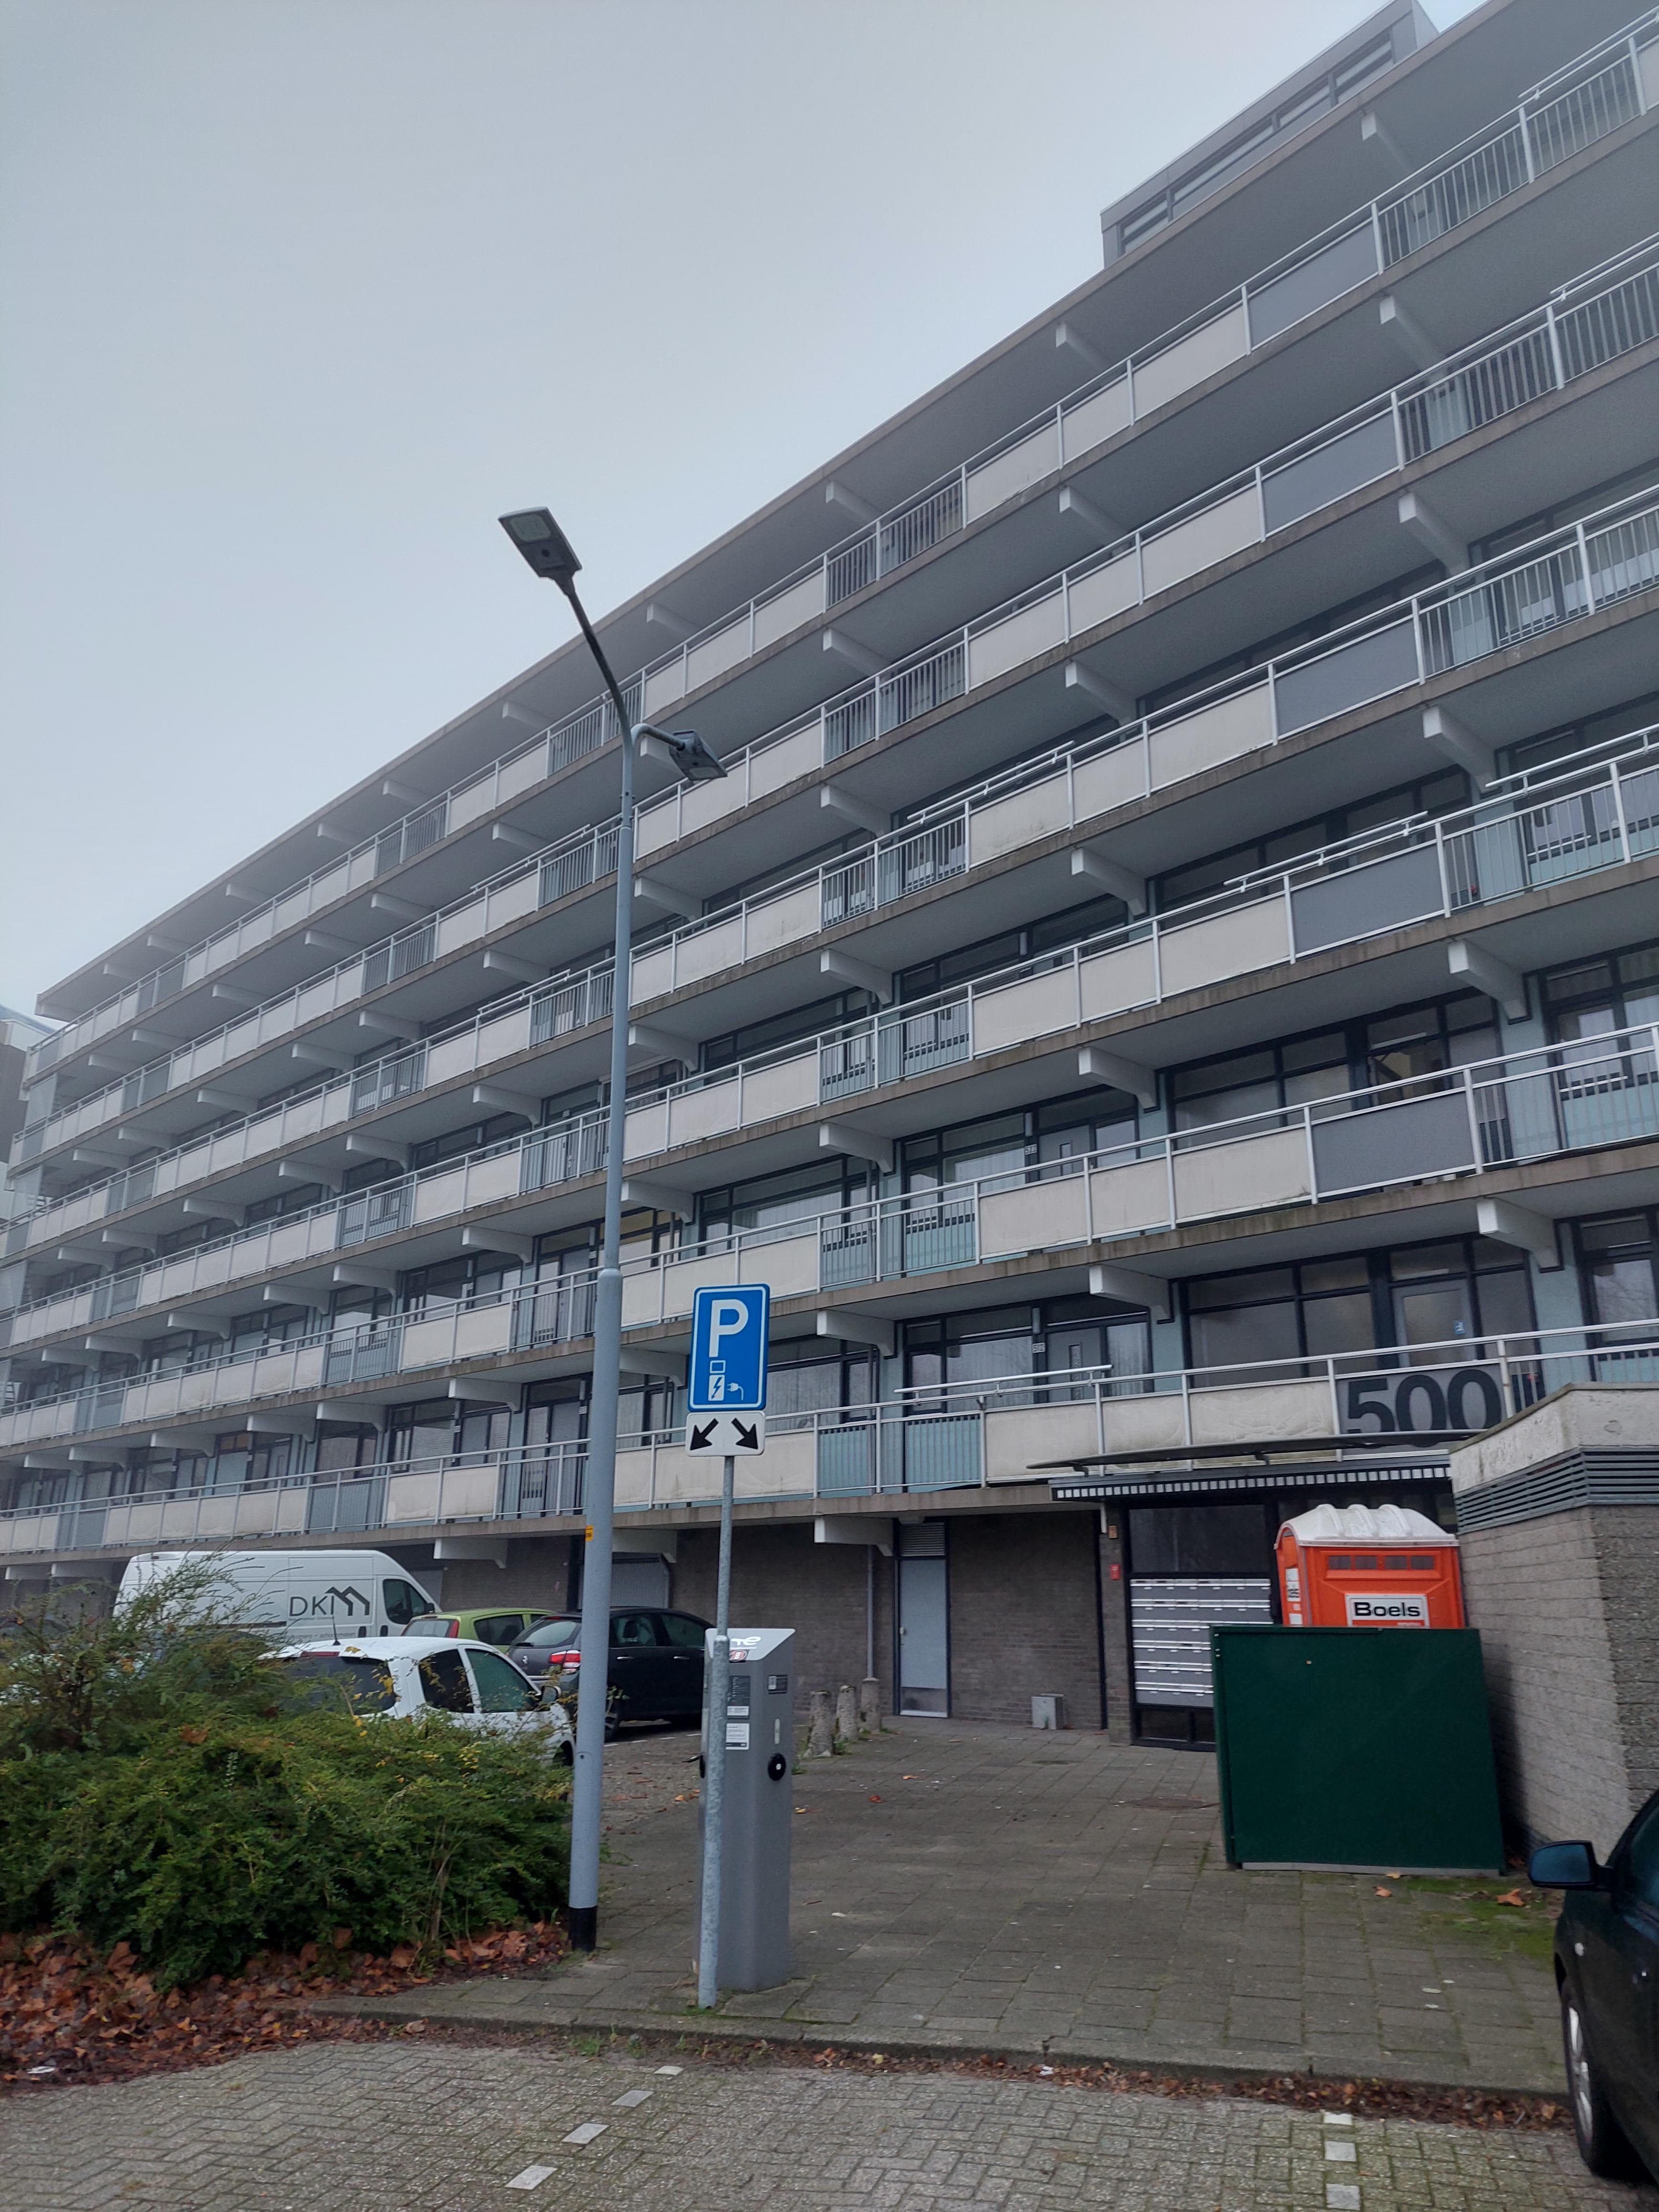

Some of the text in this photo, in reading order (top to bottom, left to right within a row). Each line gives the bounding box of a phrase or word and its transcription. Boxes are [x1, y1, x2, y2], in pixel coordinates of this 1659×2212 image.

[708, 1298, 749, 1358] P
[1347, 1369, 1502, 1447] 500
[1354, 1602, 1421, 1617] Boels
